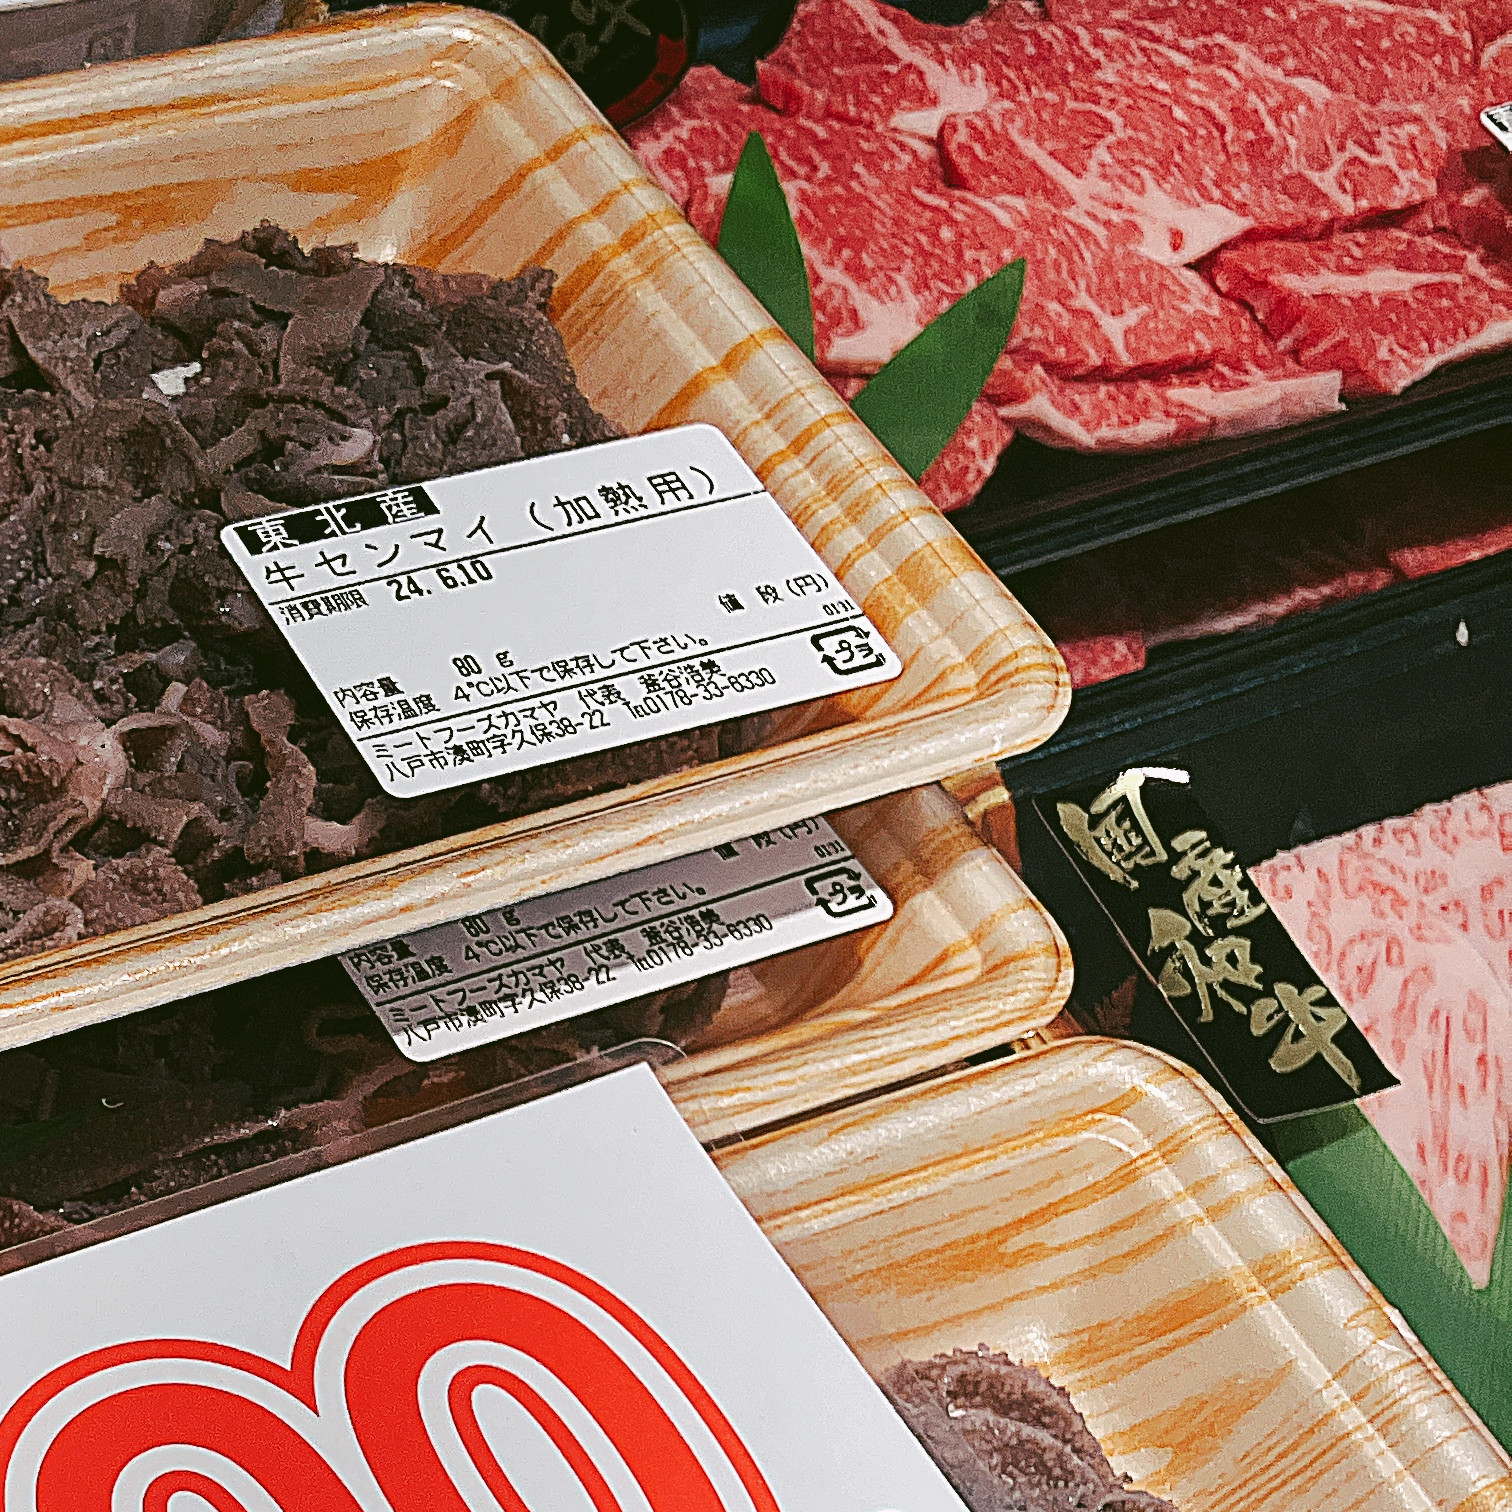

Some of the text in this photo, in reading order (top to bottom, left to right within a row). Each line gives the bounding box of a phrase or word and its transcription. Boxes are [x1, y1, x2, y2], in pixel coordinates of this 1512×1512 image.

[248, 491, 424, 554] 東北産
[279, 589, 369, 625] 消費期限
[334, 676, 405, 708] 内容量
[350, 691, 441, 731] 保存温度
[578, 681, 626, 710] 代表
[365, 955, 452, 996] 保存温度
